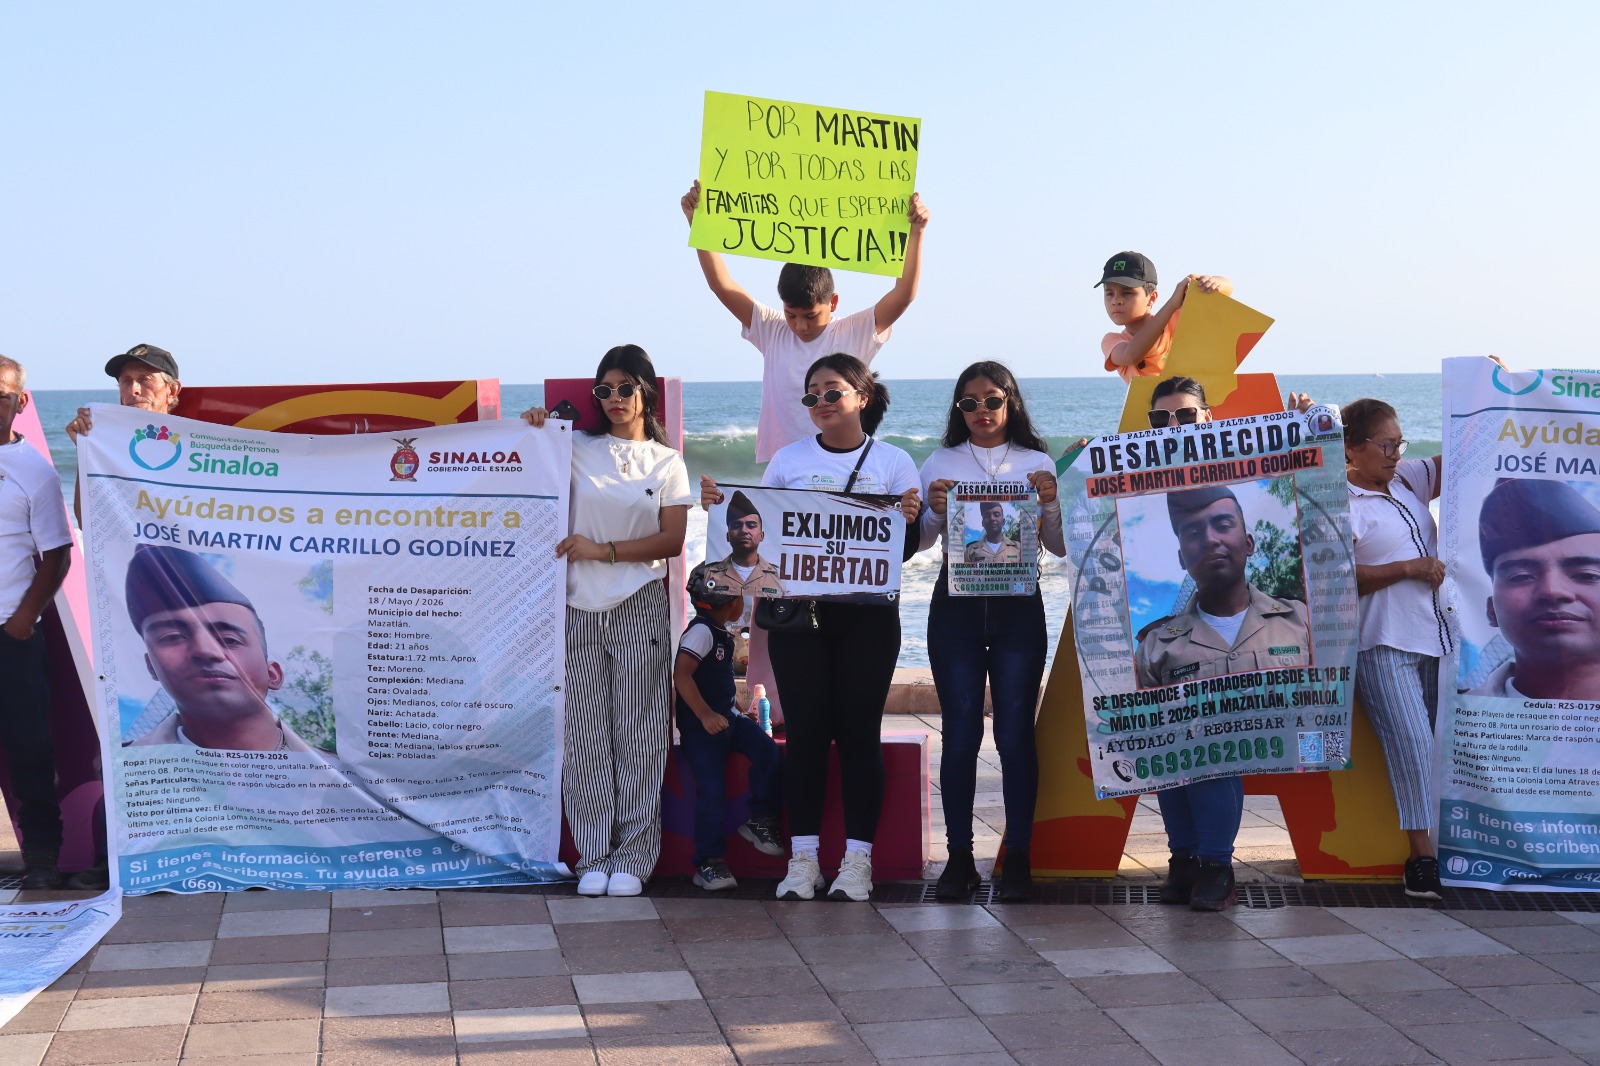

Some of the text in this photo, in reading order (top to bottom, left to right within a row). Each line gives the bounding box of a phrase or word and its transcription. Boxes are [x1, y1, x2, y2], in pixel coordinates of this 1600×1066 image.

[748, 100, 918, 152] POR MARTIN
[714, 147, 911, 182] Y POR TODAS LAS
[789, 195, 828, 221] QUE
[838, 195, 910, 218] ESPERAN
[723, 217, 907, 263] JUSTICIA!!
[1102, 434, 1120, 443] NOS
[1127, 428, 1163, 439] FALTAS
[1194, 421, 1213, 431] NOS
[1220, 416, 1257, 428] FALTAN
[1263, 411, 1294, 422] TODOS
[243, 445, 280, 454] Personas
[1090, 421, 1301, 474] DESAPARECIDO
[188, 452, 279, 477] Sinaloa
[428, 451, 522, 464] SINALOA
[1494, 452, 1600, 475] JOSÉ MA
[427, 465, 469, 473] GOBIERNO
[489, 465, 523, 473] ESTADO
[1090, 448, 1318, 496] JOSÉ MARTIN CARRILLO GODÍNEZ
[958, 485, 1024, 494] DESAPARECIDO
[136, 489, 521, 528] Ayúdanos a encontrar a
[782, 511, 892, 542] EXIJIMOS
[133, 522, 516, 558] JOSÉ MARTIN CARRILLO GODÍNEZ
[826, 540, 846, 555] SU
[780, 552, 889, 586] LIBERTAD
[368, 586, 471, 596] Fecha de Desaparición:
[389, 598, 413, 606] Mayo
[422, 598, 444, 606] 2026
[368, 609, 413, 618] Municipio
[368, 620, 411, 628] Mazatlán.
[408, 643, 429, 651] años
[451, 655, 479, 663] Aprox.
[388, 665, 425, 673] Moreno.
[368, 676, 467, 685] Complexión: Mediana.
[1093, 666, 1351, 711] SE DESCONOCE SU PARADERO DESDE EL 18 DE
[368, 698, 390, 706] Ojos:
[392, 699, 438, 707] Medianos,
[441, 700, 461, 708] color
[464, 701, 482, 709] café
[1523, 701, 1556, 709] Cedula:
[395, 710, 439, 718] Achatada.
[1109, 690, 1340, 732] MAYO DE 2026 EN MAZATLÁN, SINALOA.
[1455, 707, 1480, 717] Ropa:
[1516, 712, 1547, 721] resaque
[1561, 713, 1582, 721] color
[368, 720, 403, 728] Cabello:
[405, 722, 430, 730] Lacio,
[457, 723, 484, 732] negro.
[1185, 731, 1195, 740] A
[1204, 718, 1284, 737] REGRESAR
[1296, 718, 1305, 727] A
[1315, 712, 1347, 726] CASA!
[401, 732, 442, 740] Mediana.
[368, 741, 392, 749] Boca:
[394, 742, 435, 750] Mediana,
[195, 749, 288, 760] Cedula: RZS-0179-2026
[368, 751, 438, 760] Cejas: Pobladas.
[1135, 736, 1284, 780] 6693262089
[1453, 749, 1490, 761] Tatuajes:
[1450, 806, 1600, 835] Si tienes inform
[1450, 824, 1500, 846] llama
[1506, 839, 1517, 848] o
[130, 860, 147, 874] Si
[222, 851, 331, 864] información
[340, 846, 422, 864] referente
[431, 845, 442, 855] a
[130, 869, 179, 886] llama
[185, 866, 196, 874] o
[202, 861, 309, 879] escribenos.
[316, 869, 337, 879] Tu
[343, 865, 399, 881] ayuda
[404, 863, 425, 874] es
[431, 859, 470, 875] muy
[181, 879, 222, 891] (669)
